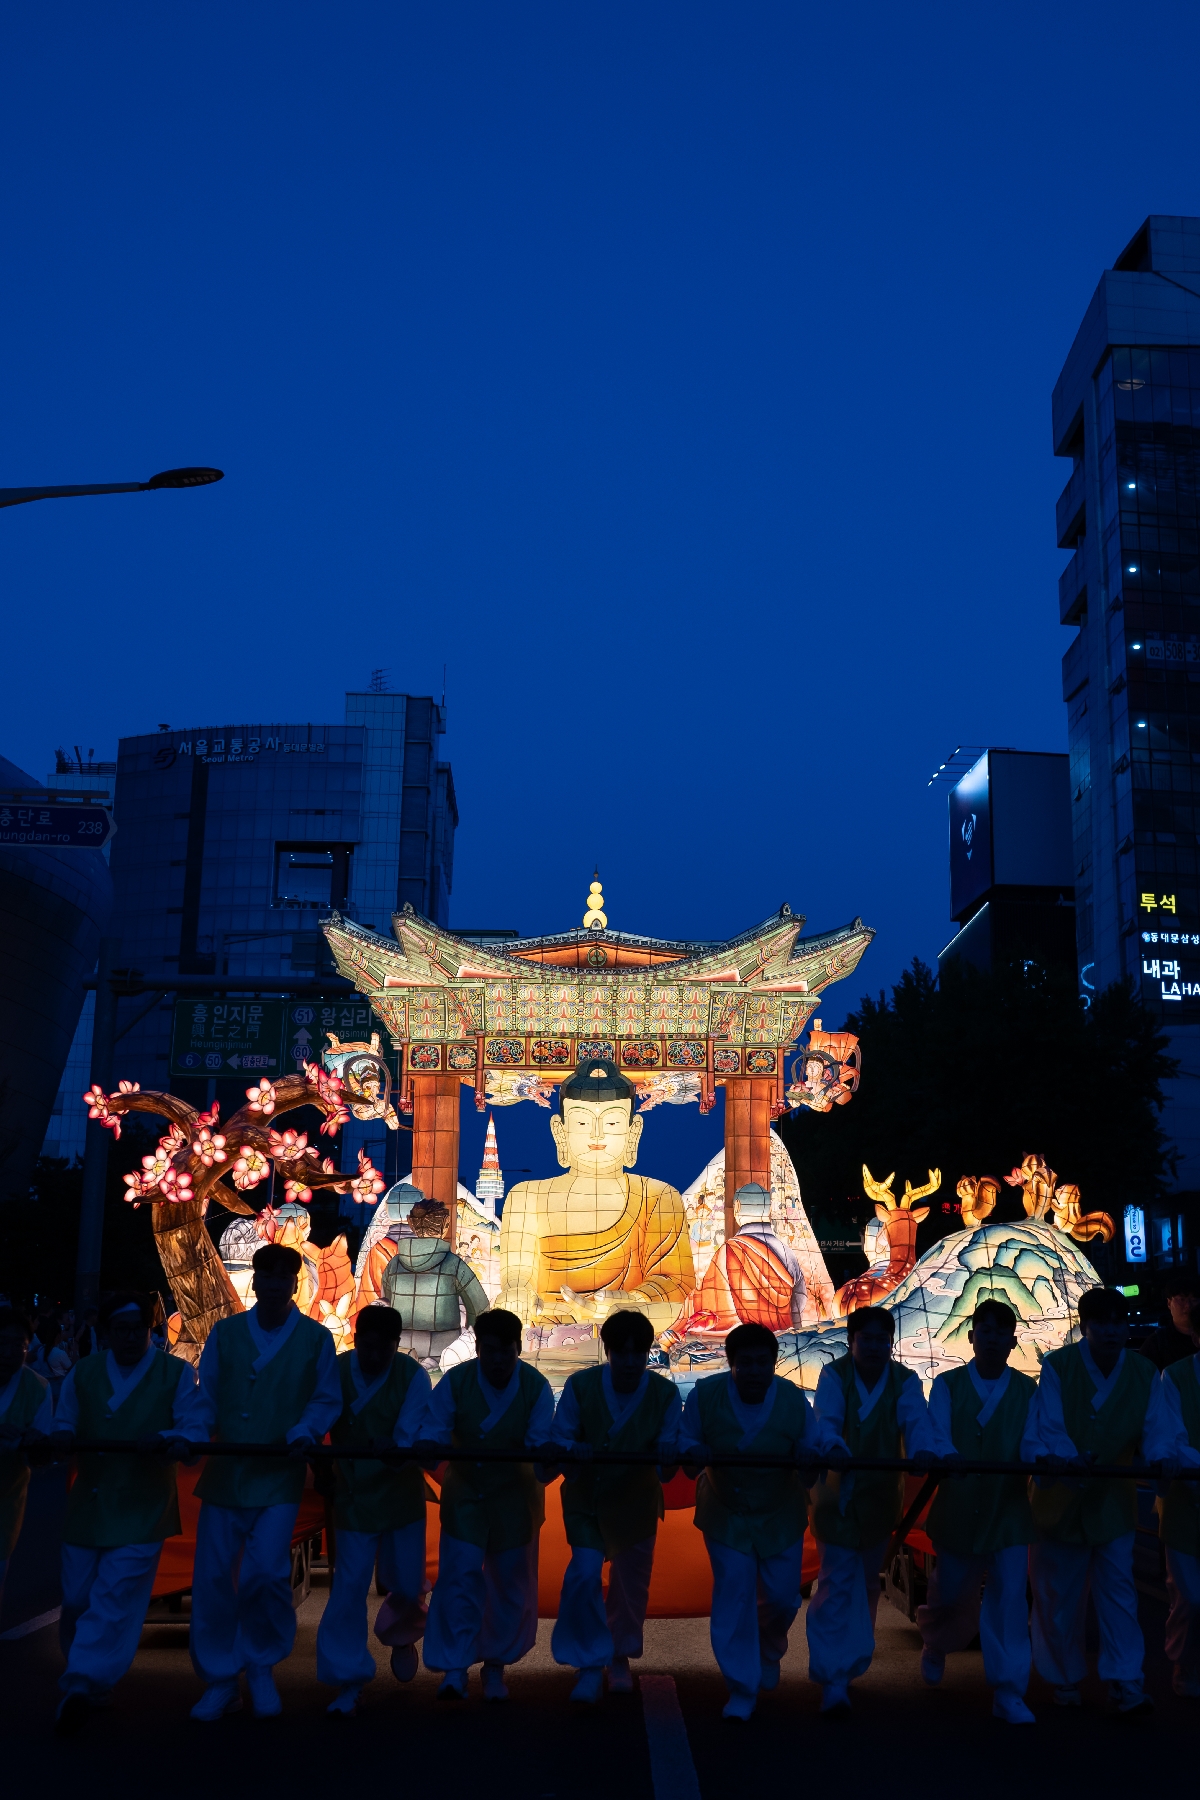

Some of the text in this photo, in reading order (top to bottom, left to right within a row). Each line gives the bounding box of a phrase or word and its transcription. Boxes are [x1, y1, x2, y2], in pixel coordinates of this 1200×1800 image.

[178, 736, 282, 756] 서울교통공사
[202, 754, 254, 764] Seoul Metro
[77, 821, 103, 835] 238
[1140, 892, 1176, 914] 투석
[1143, 959, 1181, 980] 내과
[191, 1004, 264, 1025] 흥인지문
[297, 1009, 311, 1023] 51
[320, 1007, 383, 1027] 왕십리
[191, 1024, 260, 1039] 興仁之門
[190, 1040, 252, 1051] Heunginjimun
[295, 1046, 308, 1058] 60
[185, 1055, 194, 1067] 6
[206, 1054, 220, 1067] 50
[242, 1056, 268, 1067] 장충단로
[1130, 1235, 1142, 1258] CU
